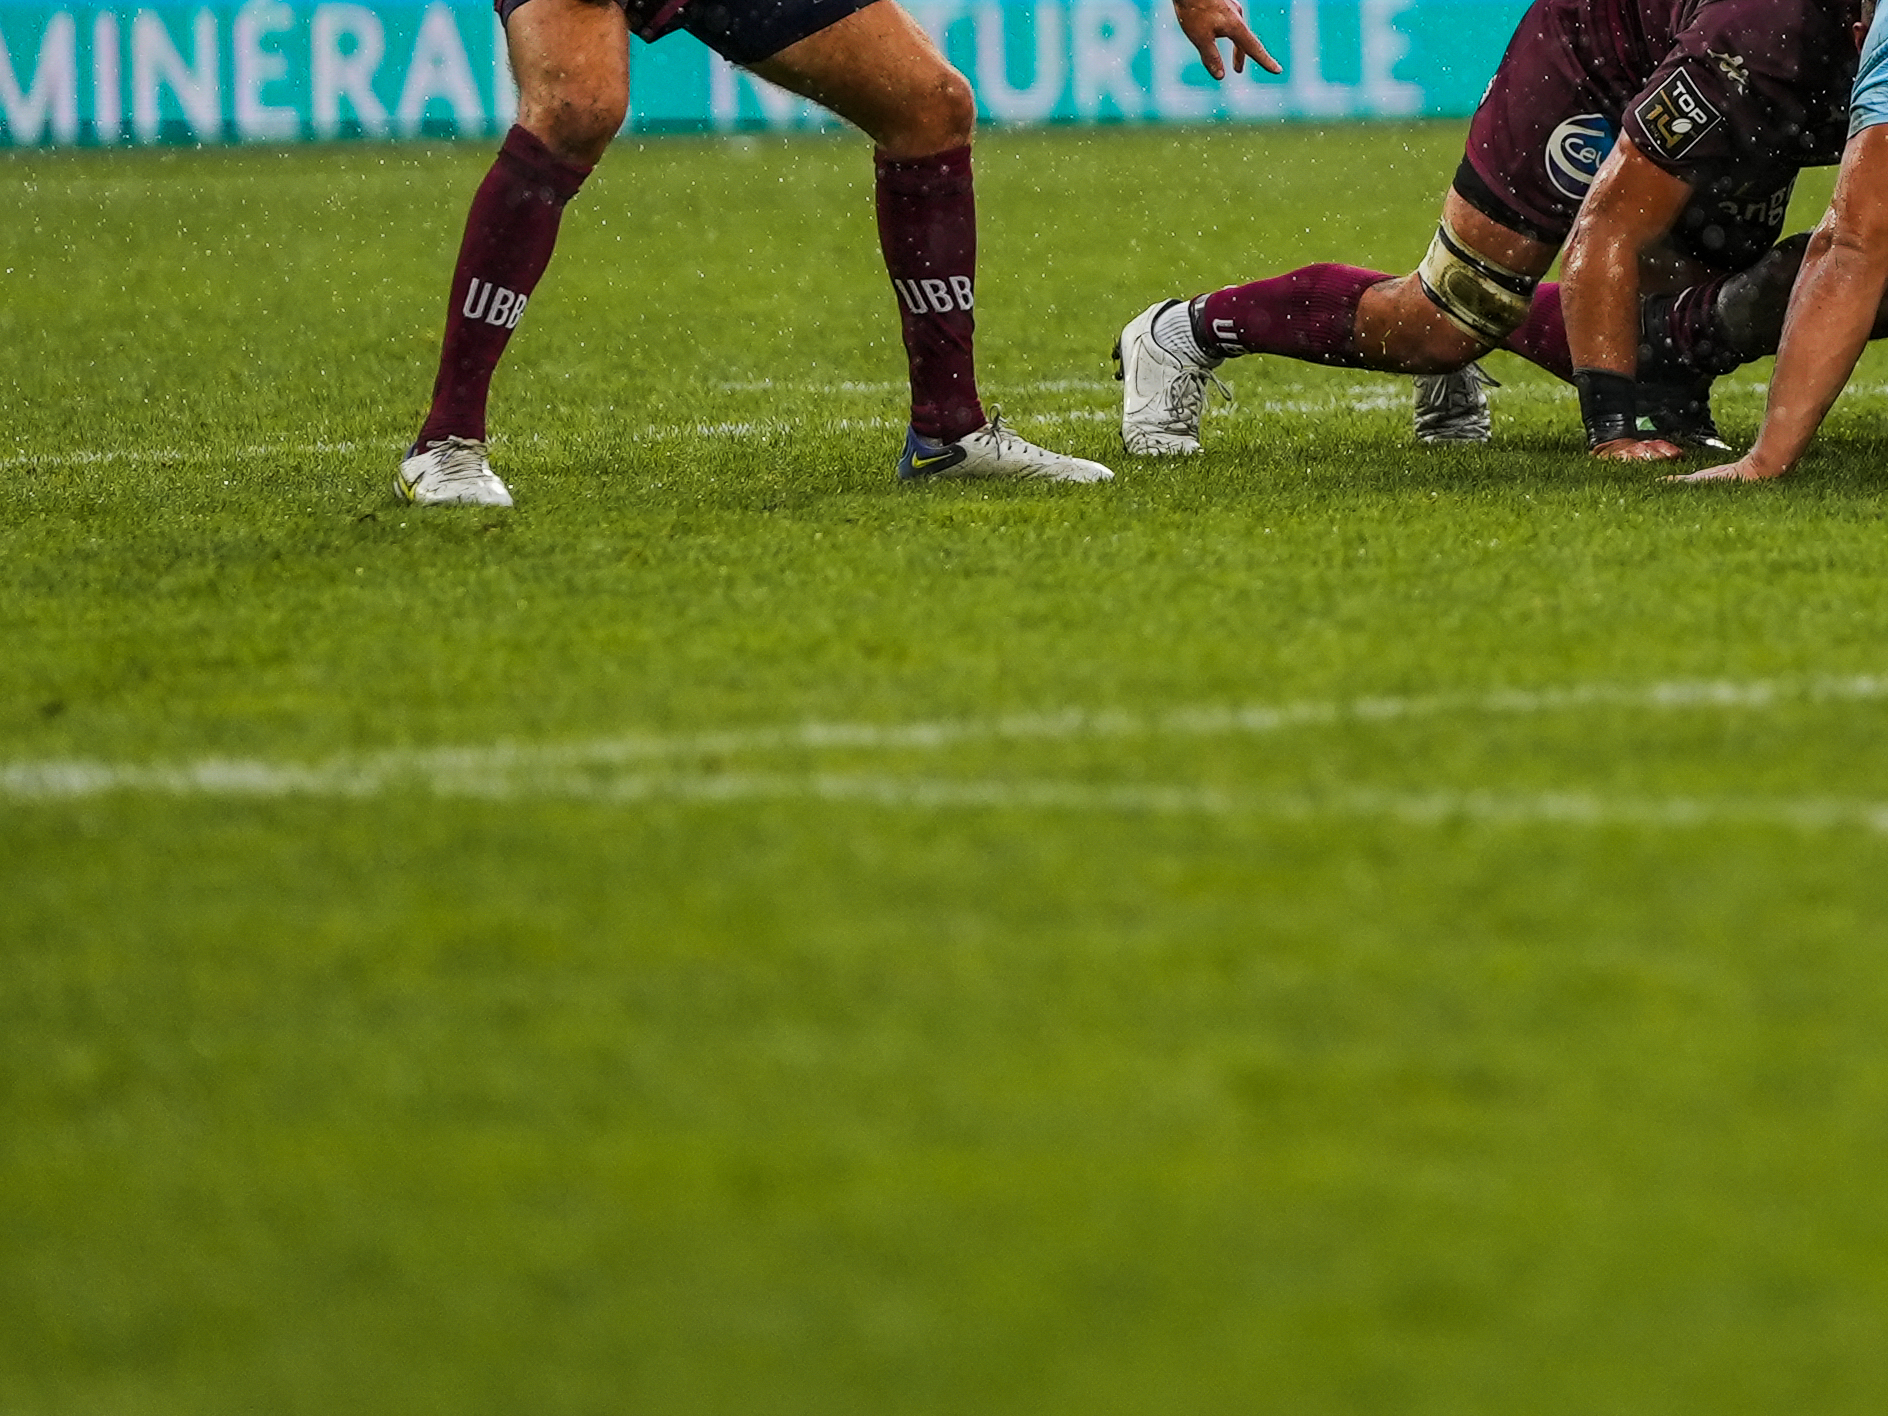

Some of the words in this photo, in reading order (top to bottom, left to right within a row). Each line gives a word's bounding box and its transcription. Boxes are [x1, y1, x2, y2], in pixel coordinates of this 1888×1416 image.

[1672, 80, 1708, 124] TOP
[463, 277, 528, 329] UBB
[894, 275, 974, 314] UBB
